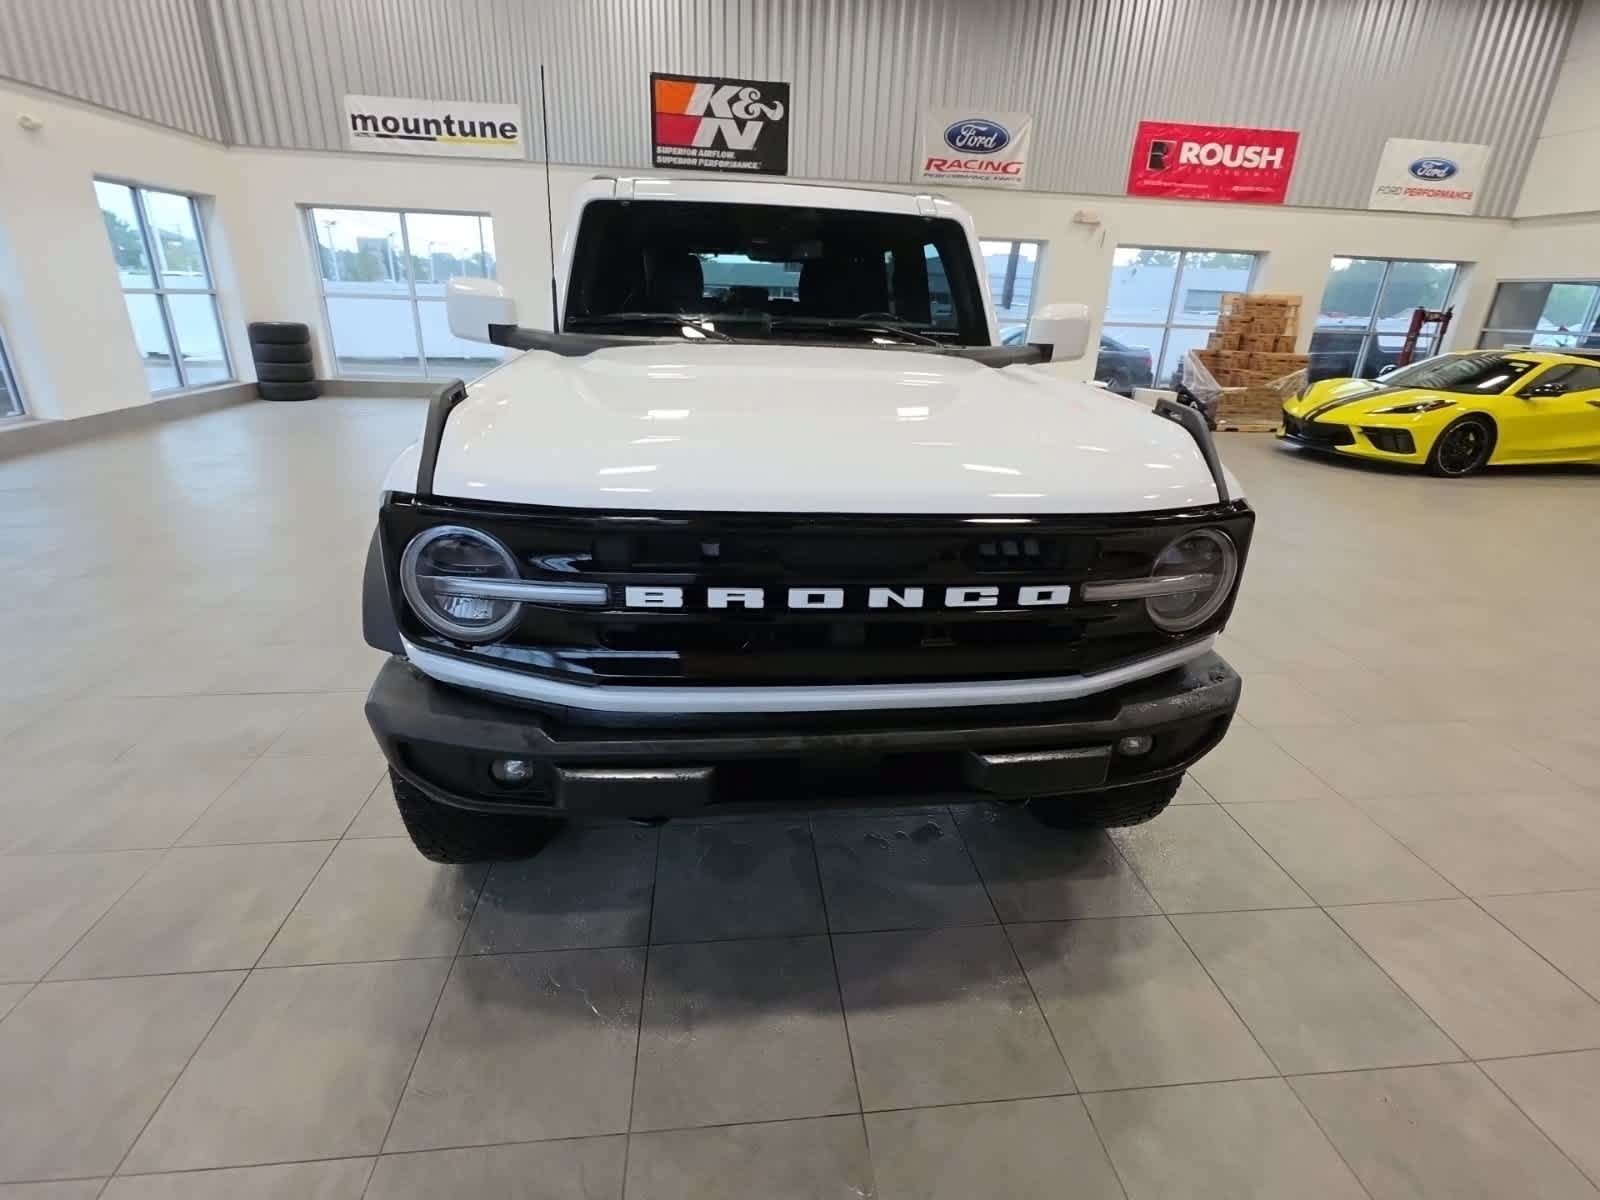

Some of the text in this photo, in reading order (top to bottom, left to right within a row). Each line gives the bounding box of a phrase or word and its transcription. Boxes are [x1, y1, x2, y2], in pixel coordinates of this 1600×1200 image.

[351, 113, 518, 139] mountune
[955, 124, 998, 148] Ford
[656, 146, 697, 157] SUPERIOR
[1179, 141, 1284, 169] ROUSH
[656, 155, 697, 166] SUPERIOR
[925, 158, 1024, 175] RACING
[1417, 160, 1449, 177] Ford
[1403, 187, 1473, 200] PERFORMANCE
[625, 585, 1072, 609] BRONCO
